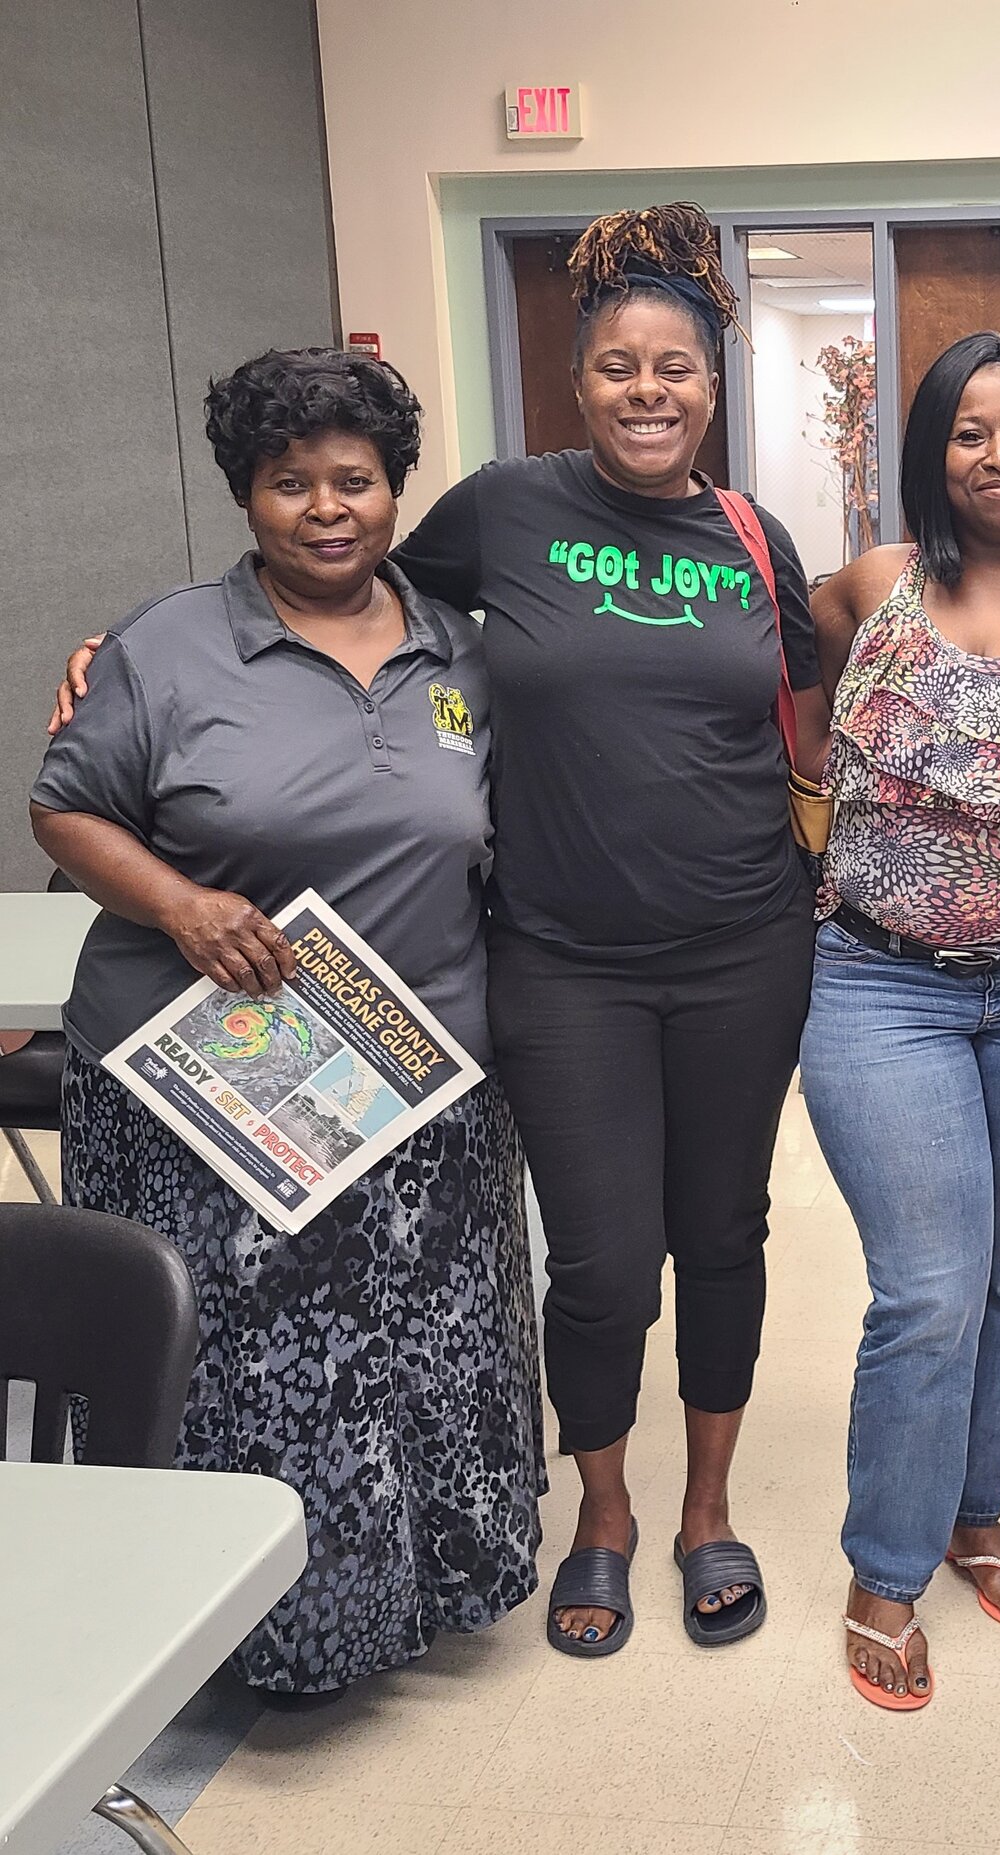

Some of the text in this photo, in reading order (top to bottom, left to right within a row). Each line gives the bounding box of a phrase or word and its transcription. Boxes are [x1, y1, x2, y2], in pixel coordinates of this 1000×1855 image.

[518, 88, 570, 132] EXIT
[291, 939, 433, 1082] HURRICANE GUIDE
[303, 927, 446, 1068] PINELLAS COUNTY
[154, 1032, 325, 1186] READY SET PROTECT
